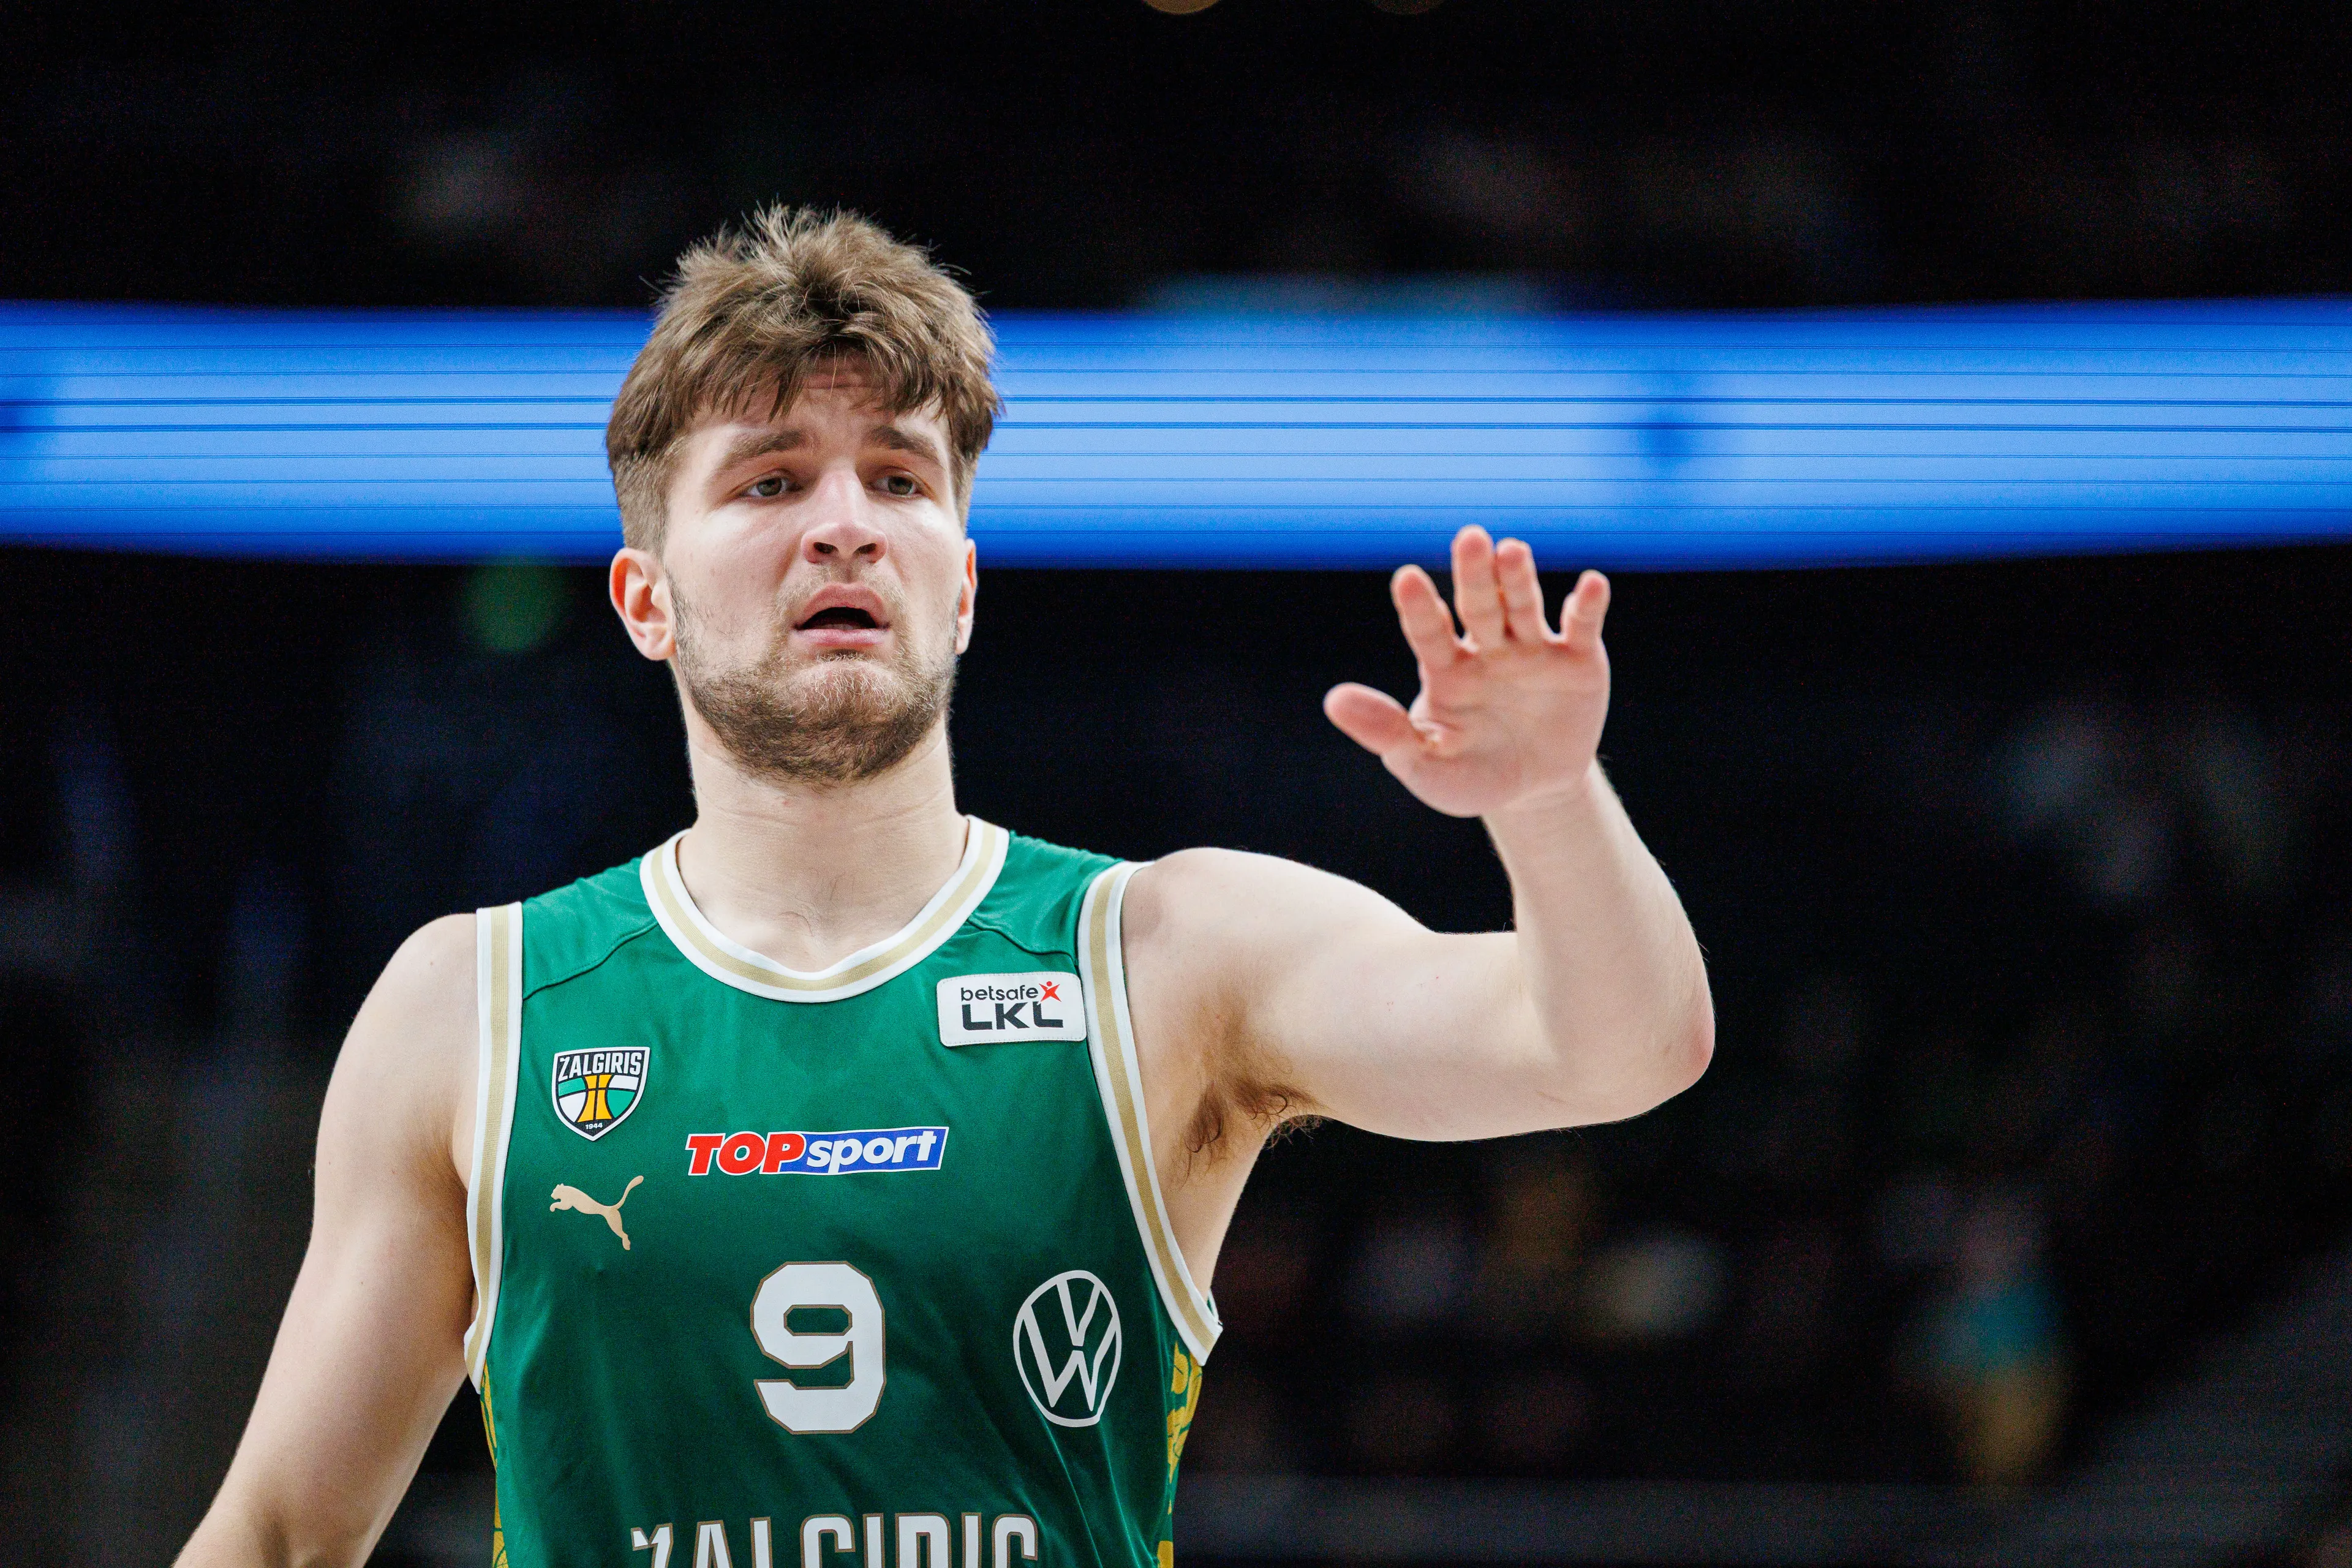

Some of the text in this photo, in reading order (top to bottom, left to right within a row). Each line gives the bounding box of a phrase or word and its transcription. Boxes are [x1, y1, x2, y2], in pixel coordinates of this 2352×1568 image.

[960, 985, 1039, 1001] betsafe
[962, 1001, 1064, 1031] LKL
[750, 1262, 886, 1434] 9
